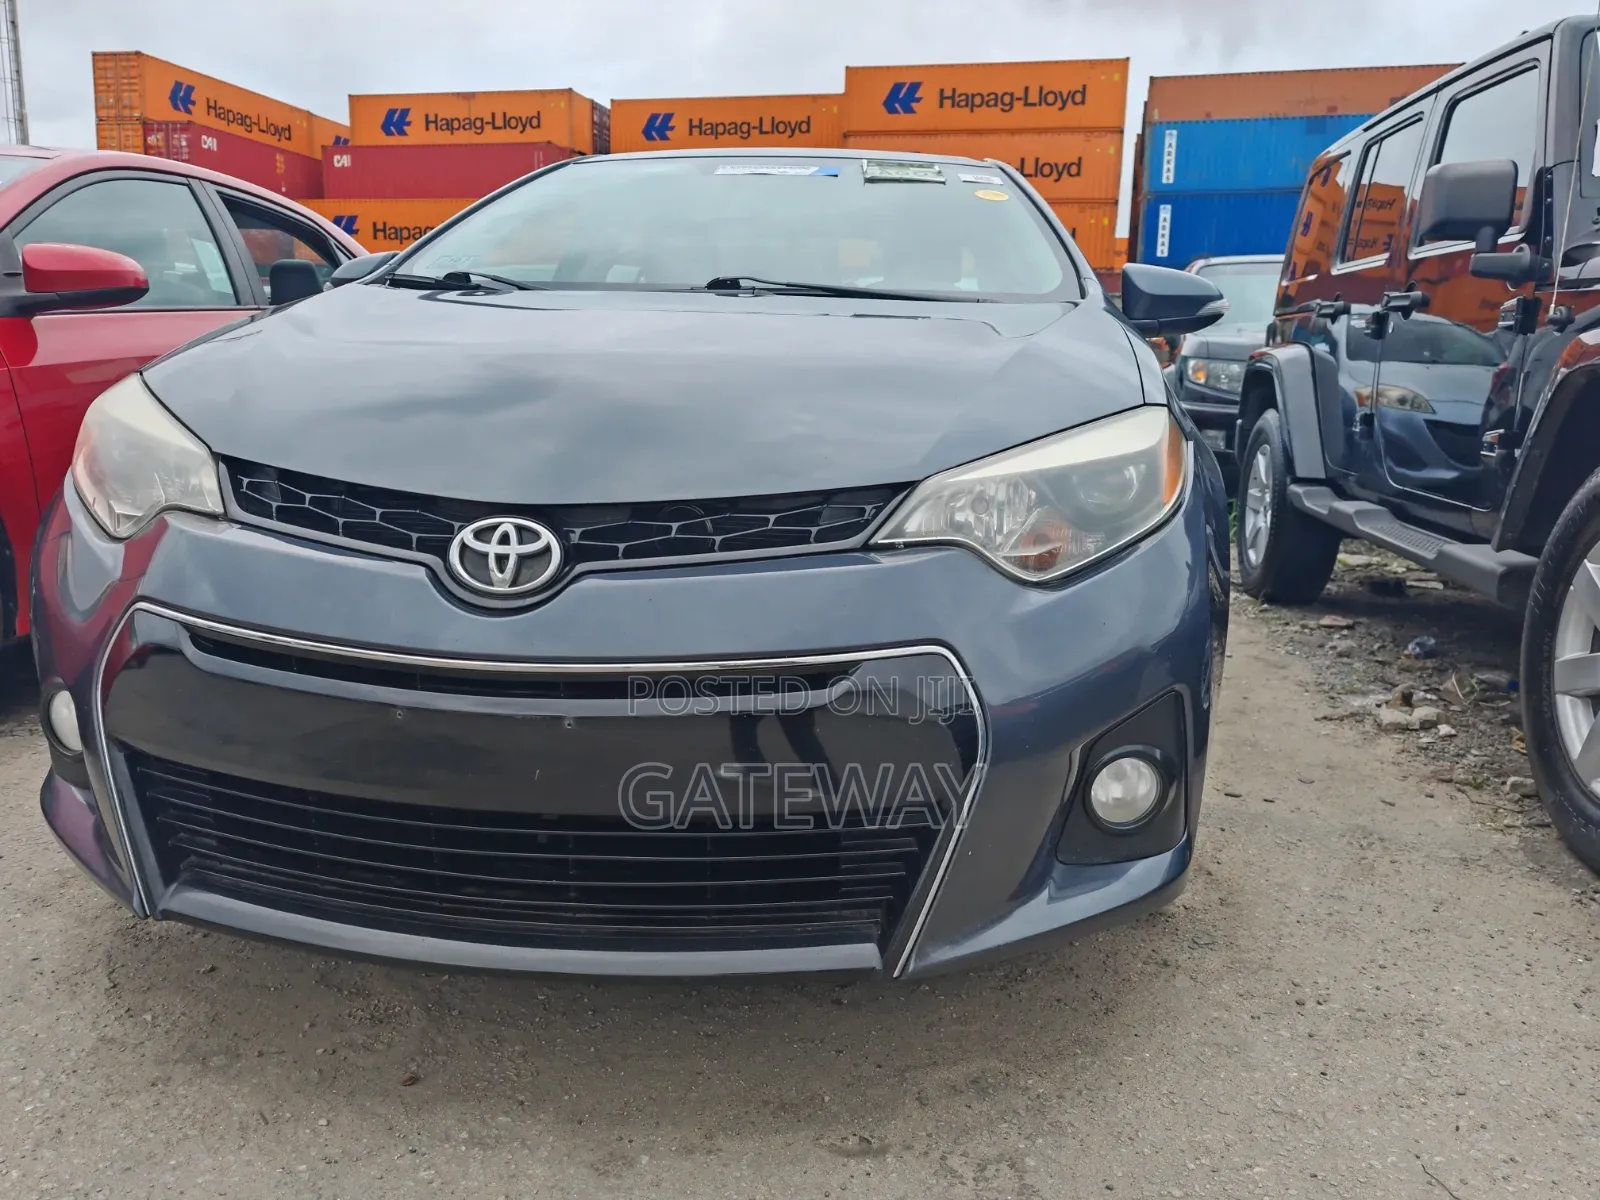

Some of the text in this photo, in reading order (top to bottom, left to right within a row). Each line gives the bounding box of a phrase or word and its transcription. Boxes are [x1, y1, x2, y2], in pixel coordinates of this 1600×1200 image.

[938, 84, 1087, 113] Hapag-Lloyd
[205, 97, 292, 141] Hapag-Lloyd
[424, 111, 541, 135] Hapag-Lloyd
[688, 115, 811, 140] Hapag-Lloyd
[201, 135, 217, 152] CAI
[333, 154, 351, 168] CAI
